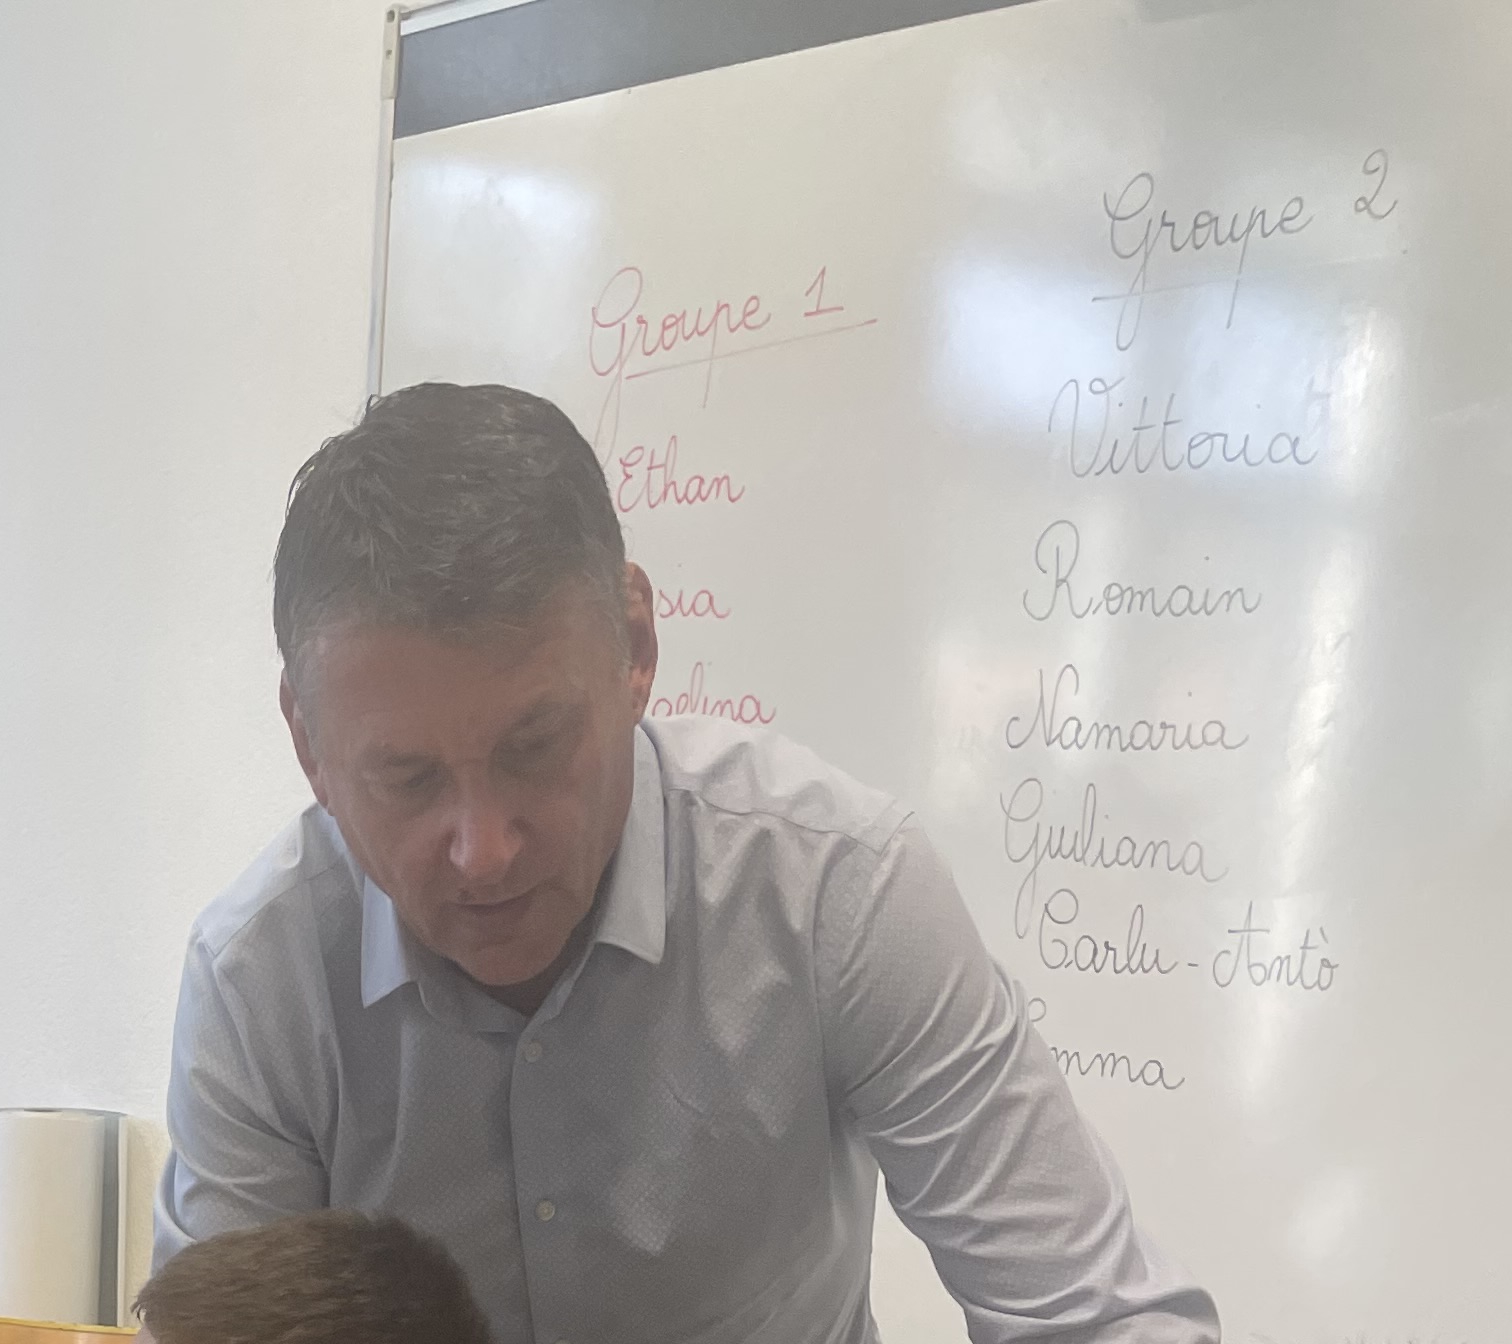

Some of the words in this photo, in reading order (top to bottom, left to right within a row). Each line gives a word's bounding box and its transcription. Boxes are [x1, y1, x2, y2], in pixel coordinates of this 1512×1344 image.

[1103, 172, 1315, 350] Groupe
[1353, 148, 1400, 220] 2
[589, 266, 773, 470] Groupe
[803, 266, 845, 318] 1
[616, 435, 746, 513] Ethan
[1048, 376, 1320, 478] Vittoria
[654, 563, 732, 619] sia
[1023, 520, 1263, 621] Romain
[1005, 664, 1249, 751] Namaria
[999, 777, 1230, 939] Giuliana
